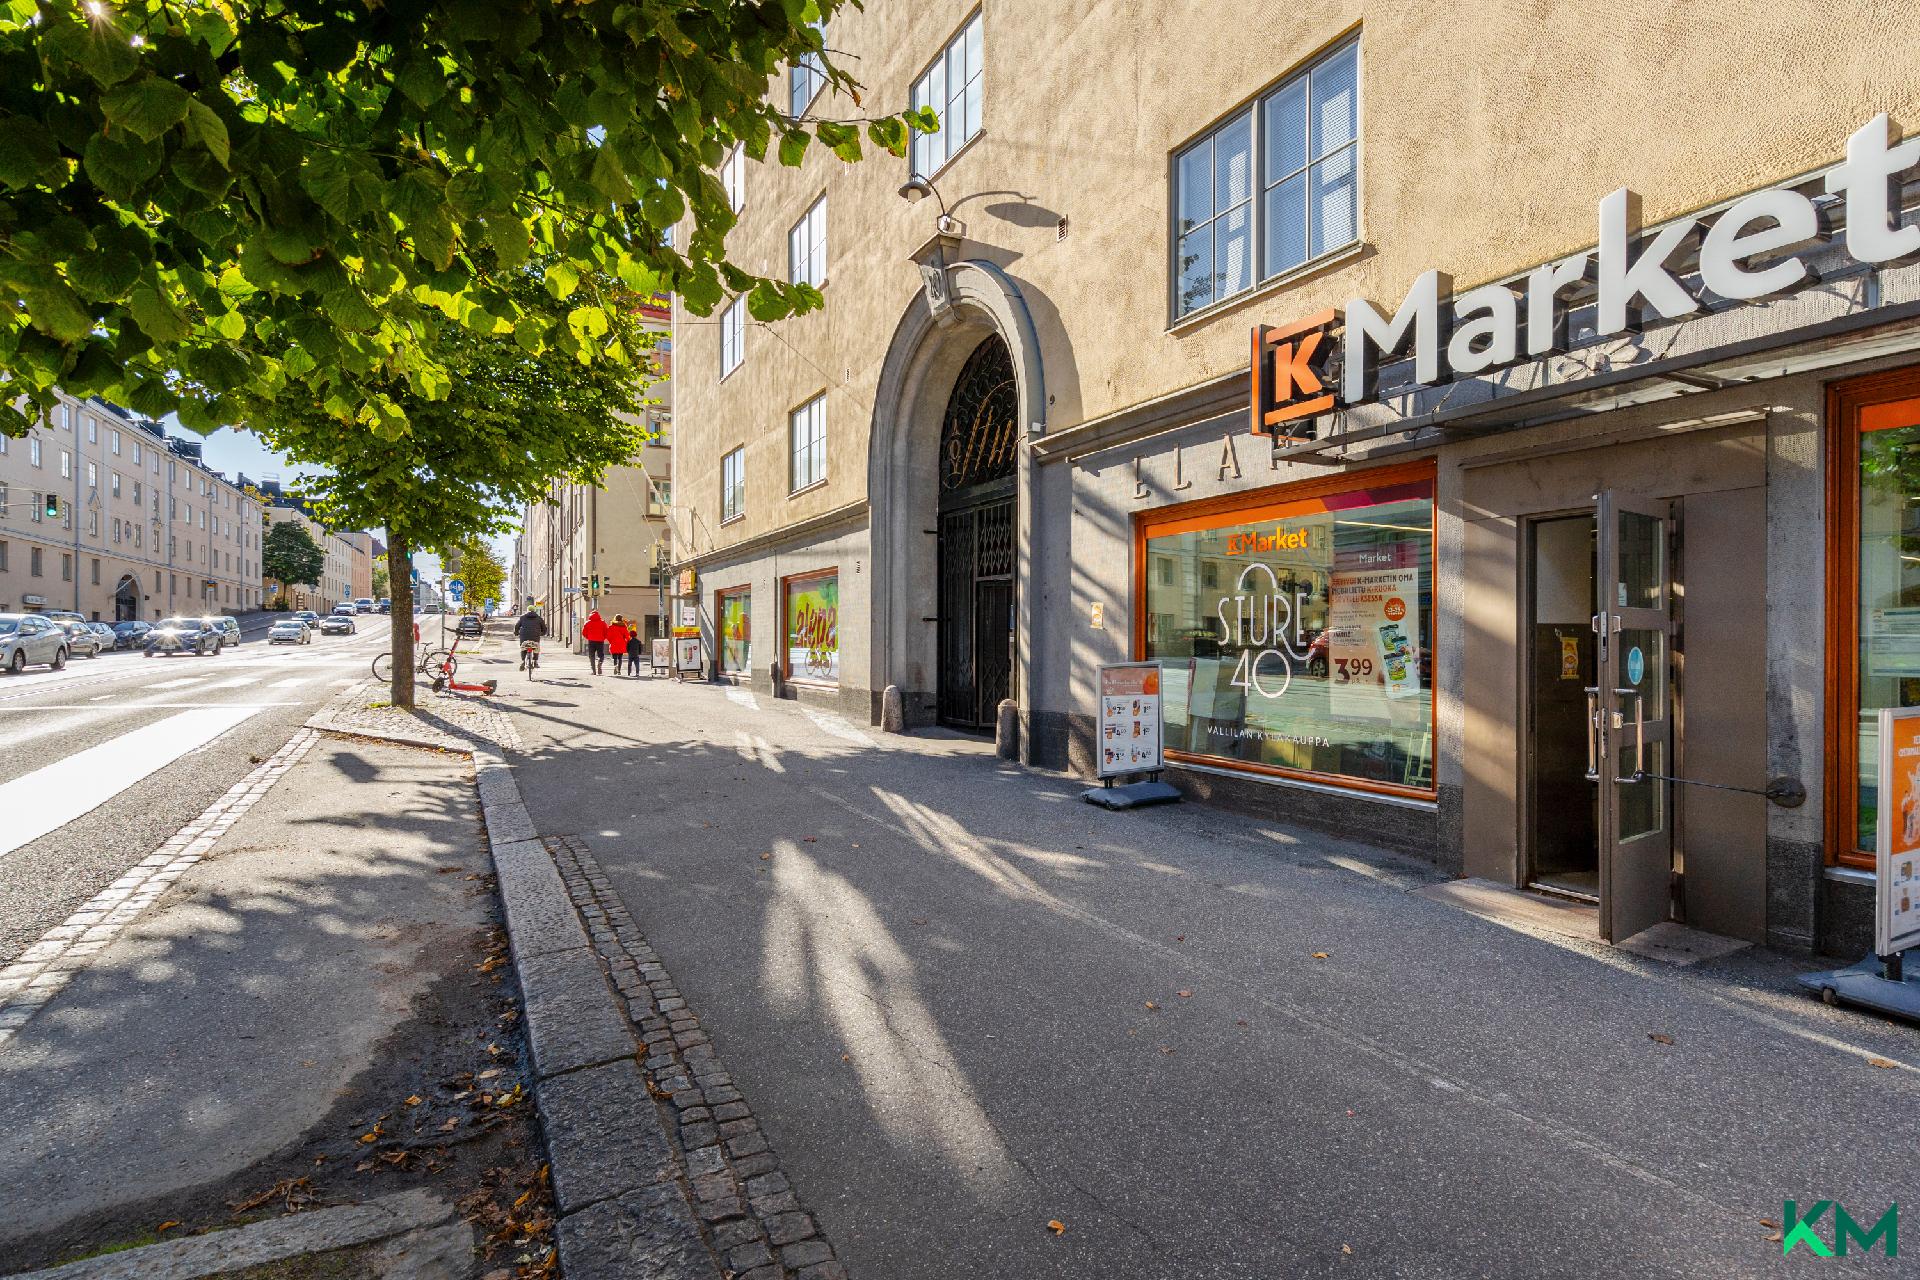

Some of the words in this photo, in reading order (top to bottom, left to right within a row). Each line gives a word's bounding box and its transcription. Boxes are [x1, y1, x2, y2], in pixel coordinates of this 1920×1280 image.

[1345, 112, 1920, 404] Market
[1241, 527, 1308, 554] Market
[1359, 552, 1392, 564] Market
[1398, 573, 1414, 583] OMA
[1218, 592, 1316, 660] STURE
[1230, 649, 1291, 698] 40
[1207, 725, 1254, 739] VALLILAN
